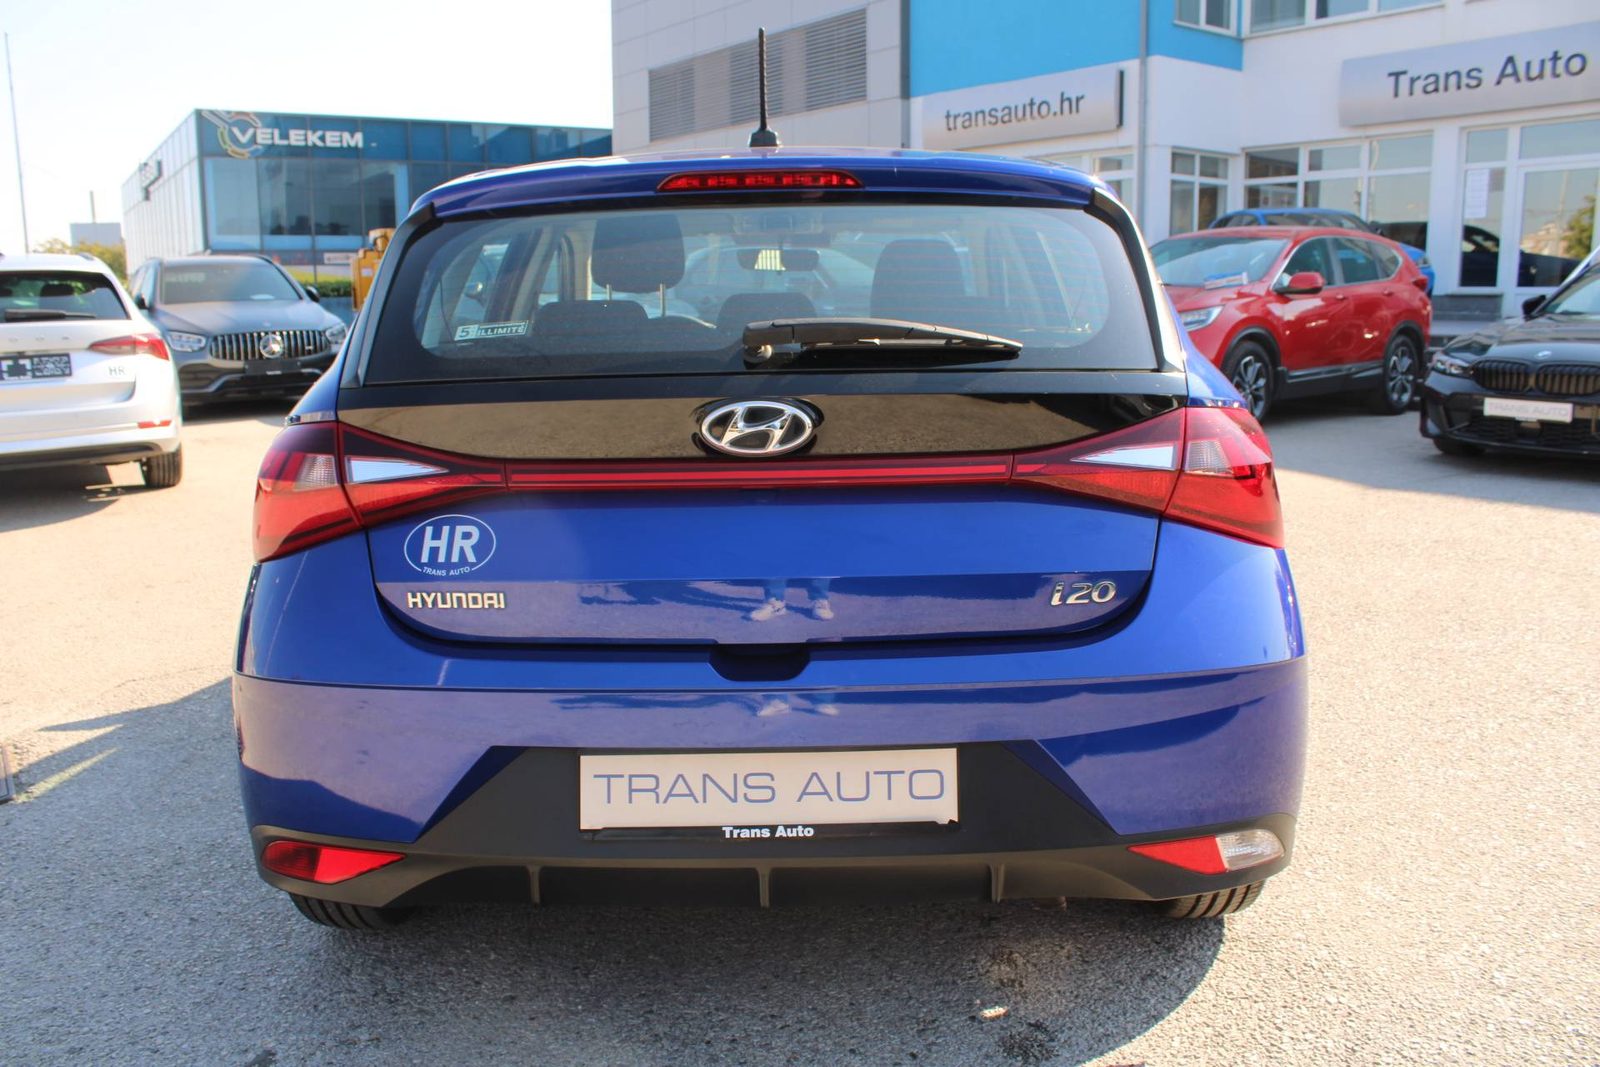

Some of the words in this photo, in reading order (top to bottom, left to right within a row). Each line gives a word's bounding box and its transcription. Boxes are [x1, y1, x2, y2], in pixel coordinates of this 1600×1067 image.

[1387, 66, 1483, 98] Trans
[1495, 50, 1588, 86] Auto
[945, 91, 1085, 131] transauto.hr
[231, 126, 363, 149] VELEKEM
[1531, 405, 1569, 418] AUTO
[420, 525, 481, 563] HR
[422, 566, 447, 577] TRANS
[448, 565, 471, 577] AUTO
[406, 592, 506, 609] HYUNDAI
[1050, 581, 1117, 606] i20
[593, 772, 777, 805] TRANS
[796, 769, 945, 802] AUTO
[722, 826, 770, 839] Trans
[774, 825, 814, 838] Auto
